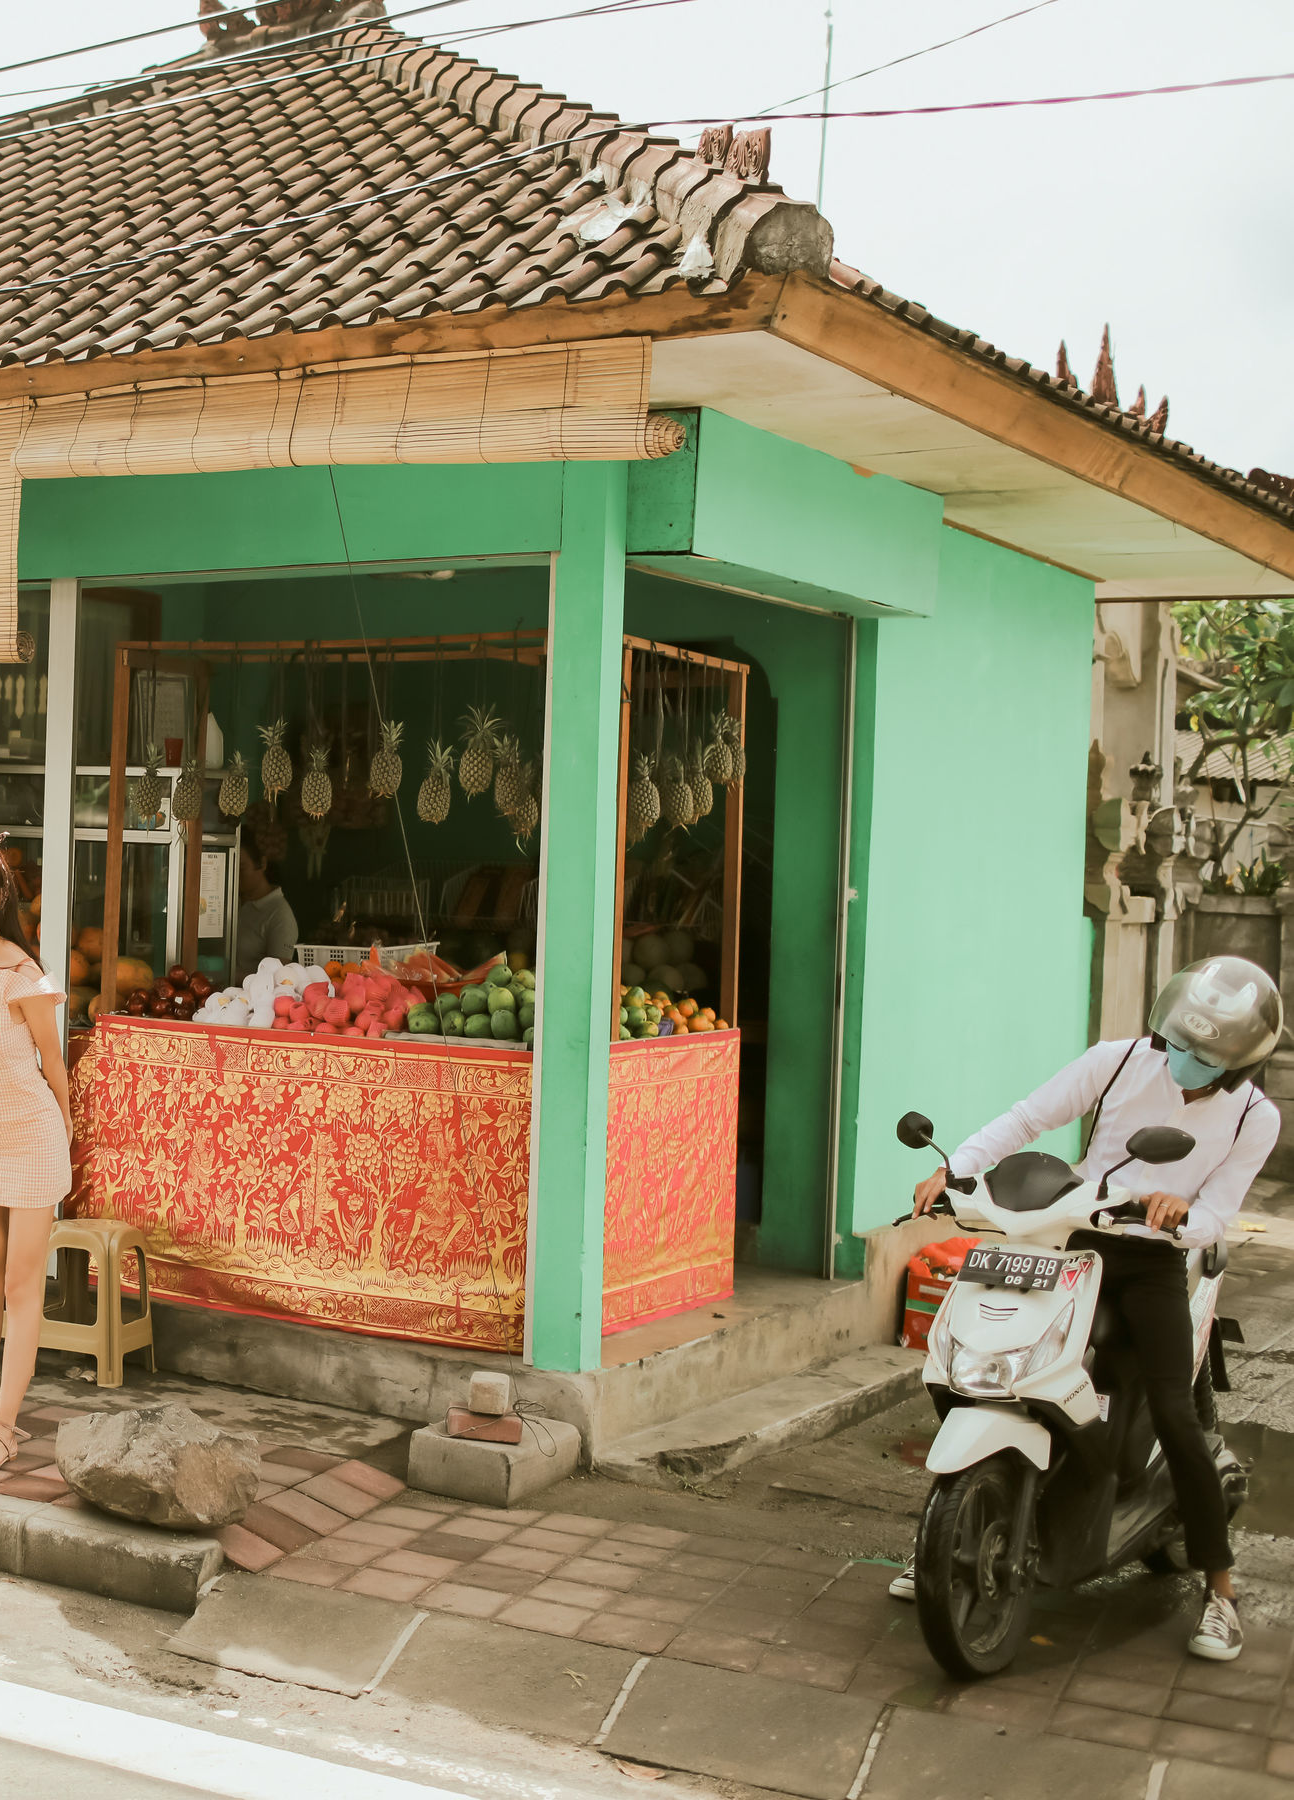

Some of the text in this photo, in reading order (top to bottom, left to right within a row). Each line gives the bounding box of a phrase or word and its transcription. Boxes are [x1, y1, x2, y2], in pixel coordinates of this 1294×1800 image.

[968, 1251, 992, 1269] DK
[995, 1254, 1033, 1273] 7199
[1034, 1258, 1058, 1276] BB
[1004, 1275, 1048, 1288] 08 21
[1063, 1381, 1089, 1406] HONDA
